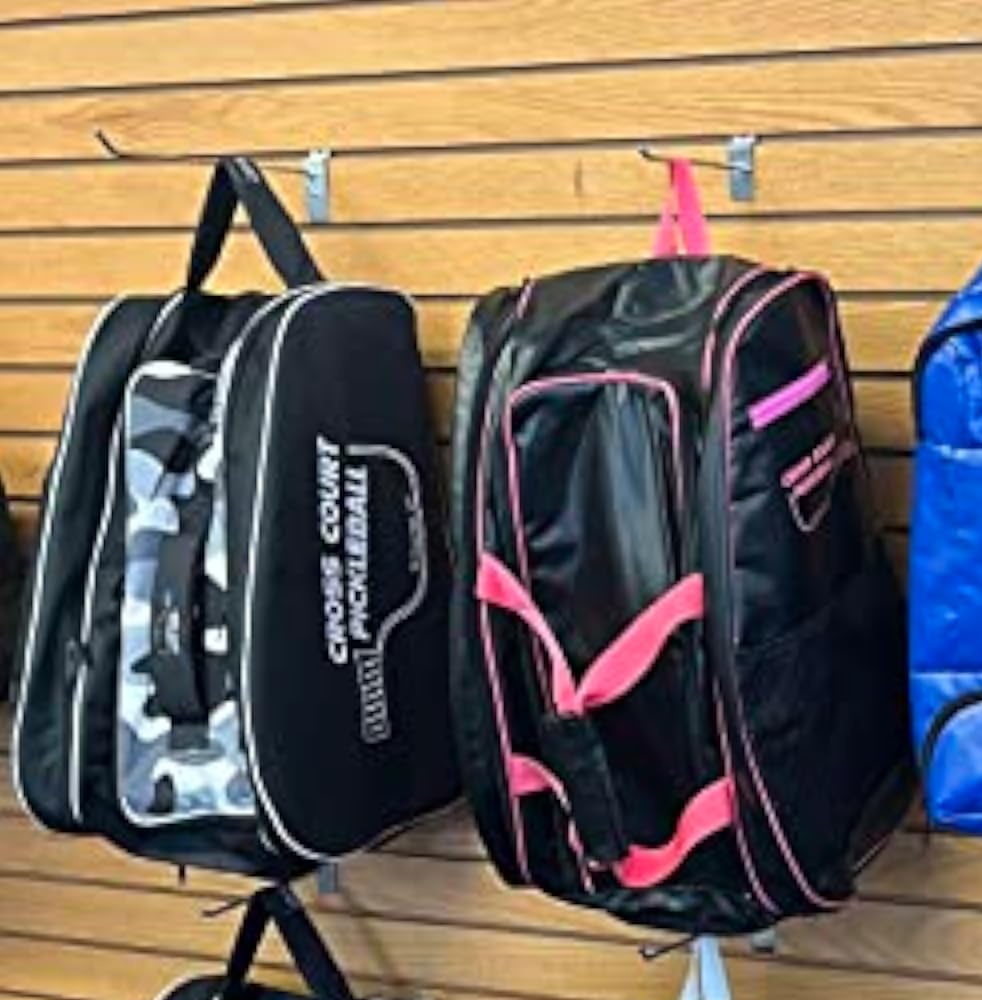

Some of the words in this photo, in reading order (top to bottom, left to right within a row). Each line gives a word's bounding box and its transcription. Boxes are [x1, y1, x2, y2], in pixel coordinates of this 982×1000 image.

[316, 434, 340, 544] COURT
[345, 464, 371, 642] PICKLEBALL
[320, 555, 348, 664] CROSS
